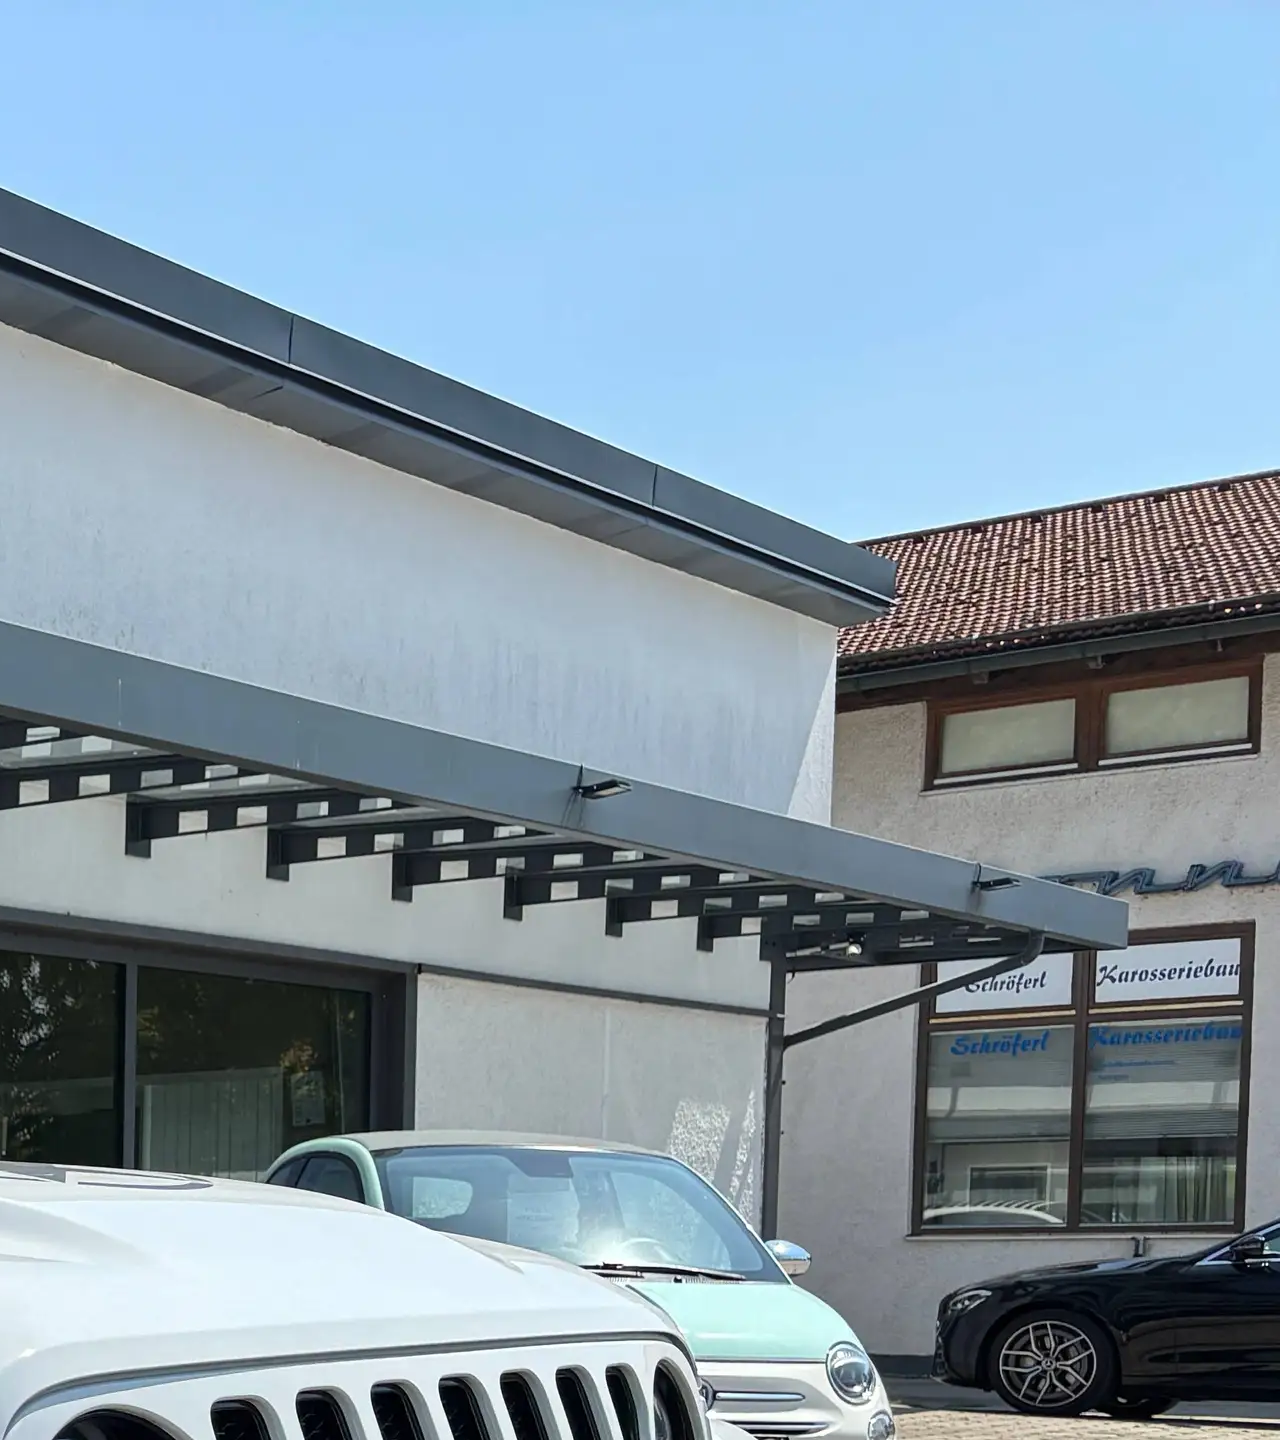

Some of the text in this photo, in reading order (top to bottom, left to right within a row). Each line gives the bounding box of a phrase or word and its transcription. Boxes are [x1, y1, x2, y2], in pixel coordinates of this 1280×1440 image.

[1096, 957, 1242, 987] Karosseriebau
[950, 1020, 1244, 1057] Schröferl Karosseriebau
